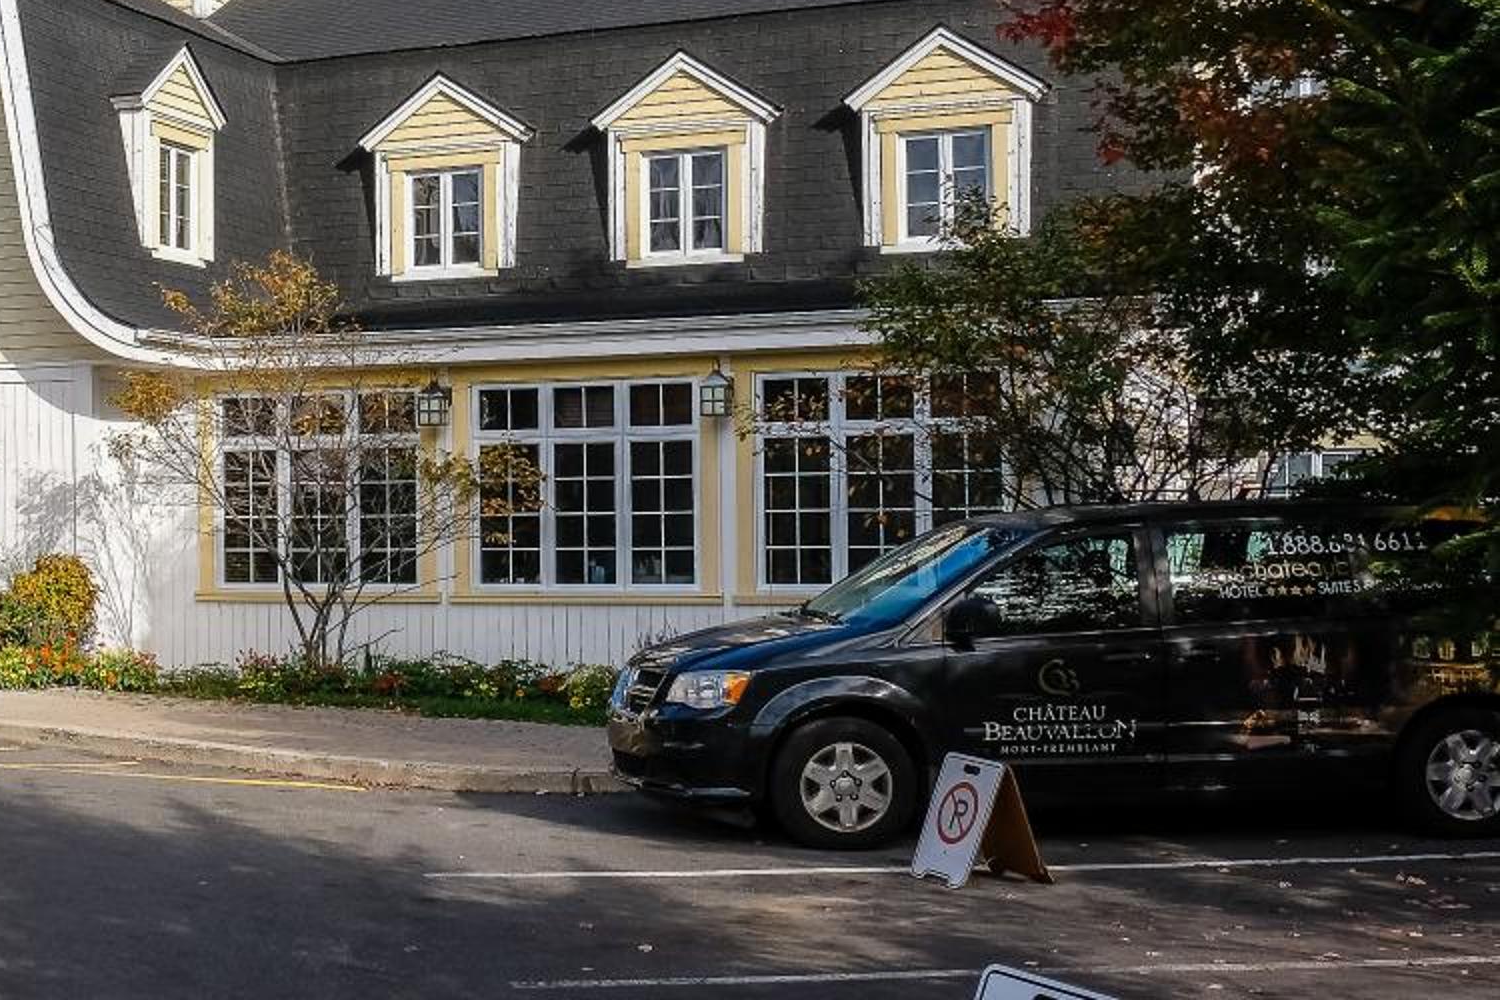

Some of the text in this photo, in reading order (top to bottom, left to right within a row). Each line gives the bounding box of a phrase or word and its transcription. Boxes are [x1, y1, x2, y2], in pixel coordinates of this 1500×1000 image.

[1317, 580, 1361, 596] SUITES
[1013, 703, 1106, 722] CHÂTEAU
[983, 719, 1137, 741] BEAUVALLON
[1001, 743, 1117, 754] MONT-TREMBLANT
